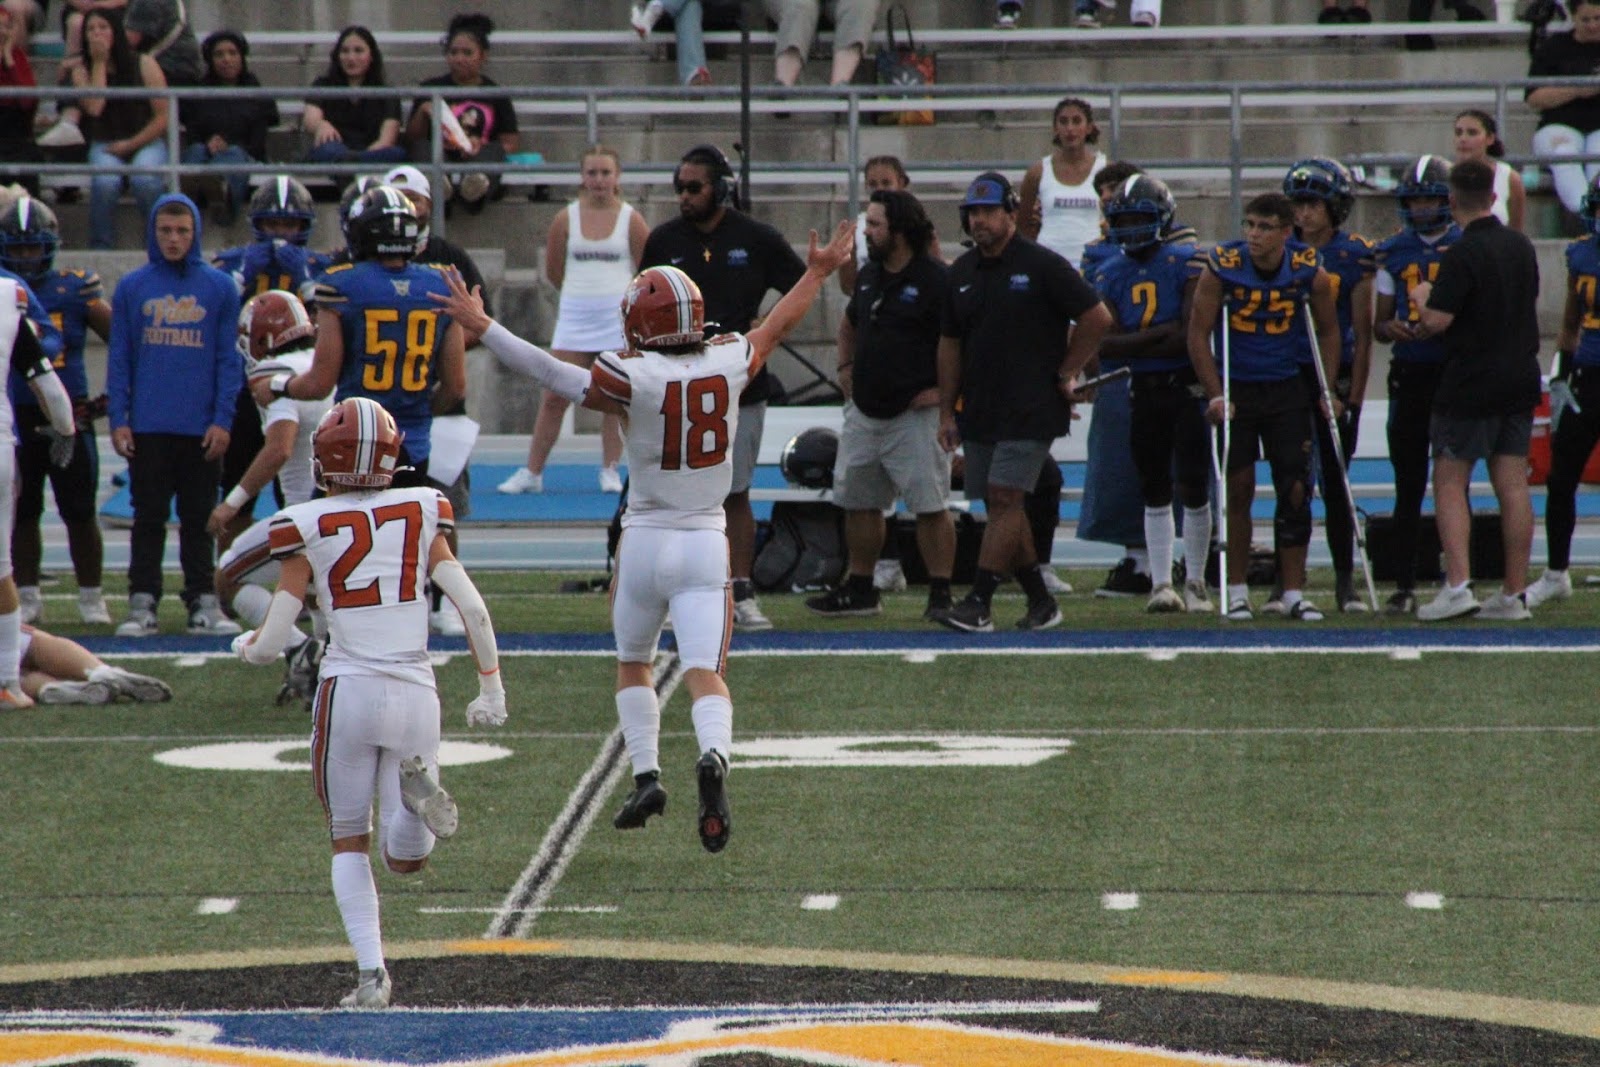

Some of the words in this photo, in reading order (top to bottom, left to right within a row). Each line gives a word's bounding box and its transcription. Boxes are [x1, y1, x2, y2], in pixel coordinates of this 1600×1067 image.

[143, 326, 204, 348] FOOTBALL
[1230, 289, 1295, 335] 25
[361, 308, 438, 393] 58
[659, 374, 729, 471] 18
[332, 474, 362, 486] WEST
[317, 500, 423, 611] 27
